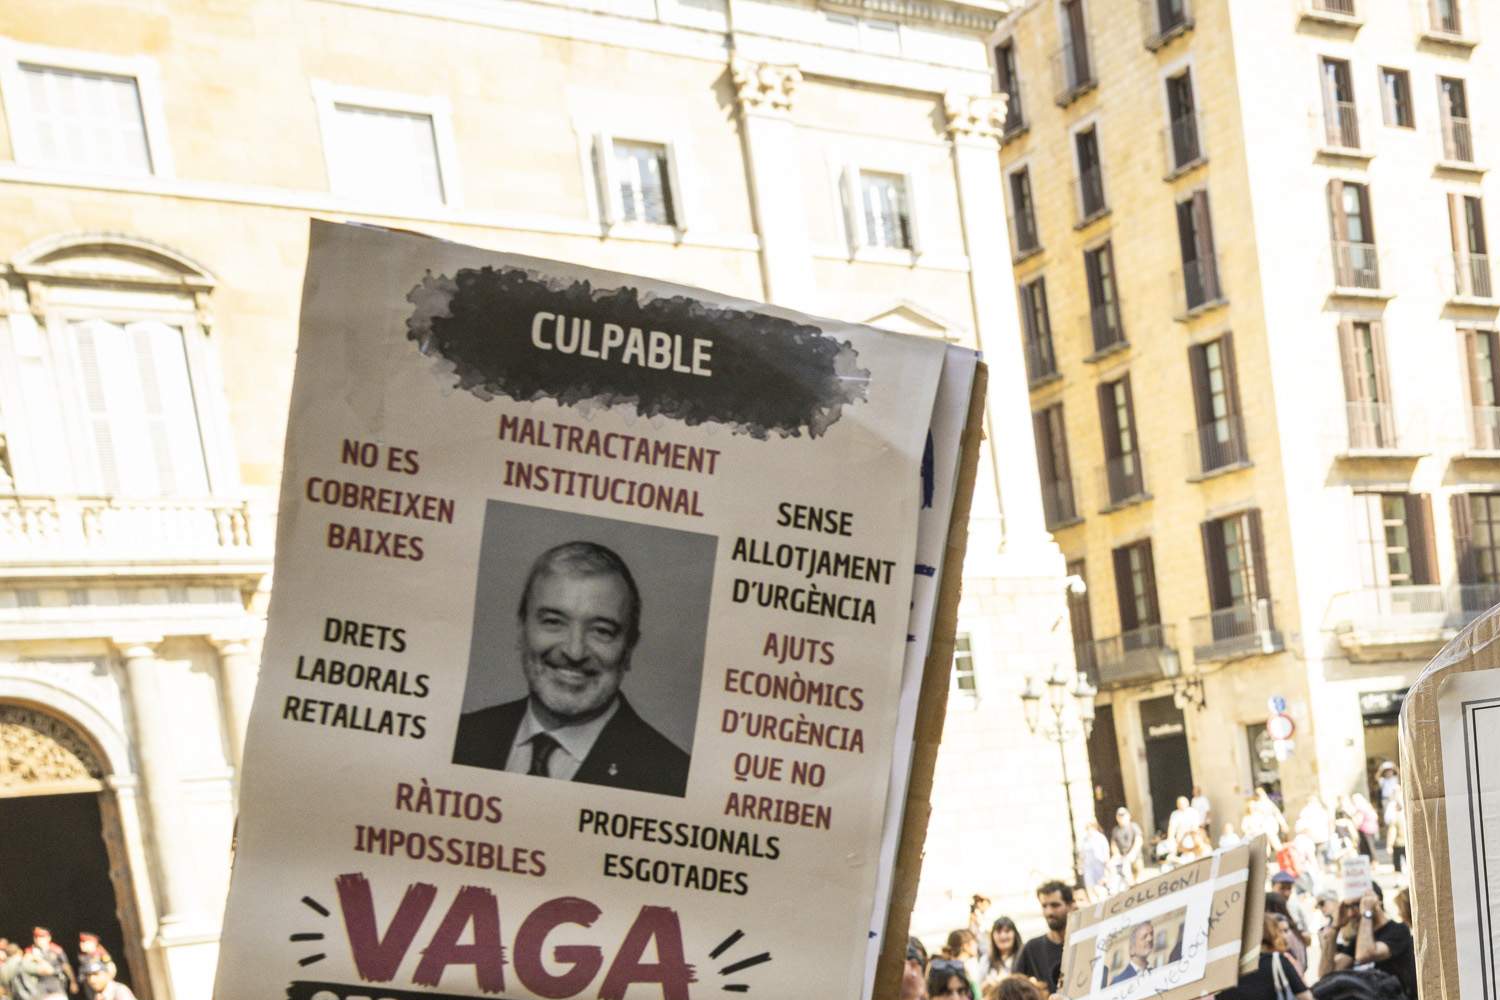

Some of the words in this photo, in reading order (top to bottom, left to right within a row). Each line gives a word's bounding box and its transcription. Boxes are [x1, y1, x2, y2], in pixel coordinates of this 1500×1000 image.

[530, 311, 714, 377] CULPABLE
[341, 437, 381, 471] NO
[387, 447, 420, 475] ES
[499, 413, 721, 476] MALTRACTAMENT
[305, 476, 455, 525] COBREIXEN
[503, 459, 704, 518] INSTITUCIONAL
[326, 522, 425, 563] BAIXES
[776, 502, 854, 538] SENSE
[731, 536, 896, 586] ALLOTJAMENT
[731, 577, 878, 626] D'URGÈNCIA
[322, 616, 408, 655] DRETS
[762, 632, 836, 667] AJUTS
[294, 655, 431, 700] LABORALS
[724, 664, 865, 713] ECONÒMICS
[282, 695, 427, 741] RETALLATS
[720, 707, 865, 755] D'URGÈNCIA
[733, 752, 786, 787] QUE
[790, 759, 826, 789] NO
[395, 780, 503, 825] RÀTIOS
[723, 791, 833, 830] ARRIBEN
[353, 825, 547, 878] IMPOSSIBLES
[578, 809, 781, 860] PROFESSIONALS
[603, 853, 750, 897] ESGOTADES
[1111, 869, 1200, 914] COLLBONI
